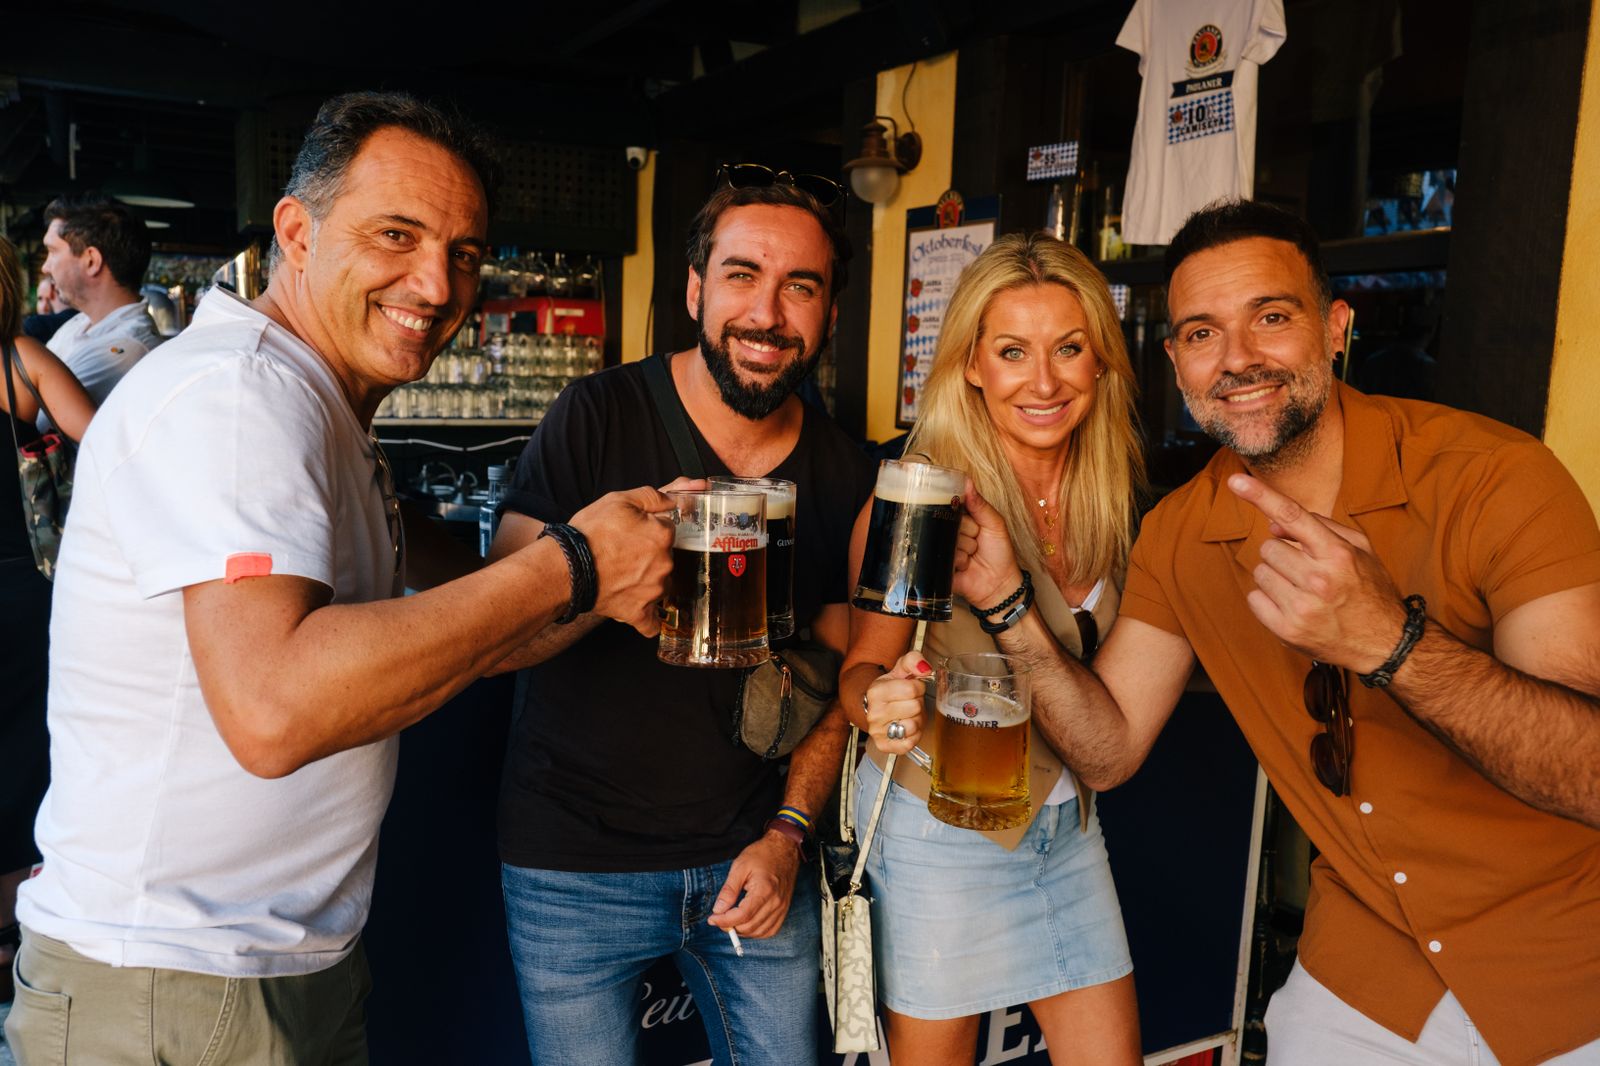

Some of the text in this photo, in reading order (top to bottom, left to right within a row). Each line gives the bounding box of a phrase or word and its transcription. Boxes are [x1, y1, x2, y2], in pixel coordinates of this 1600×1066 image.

[911, 233, 984, 262] Oktoberfest
[711, 536, 758, 552] Affligem
[946, 713, 999, 728] PAULANER
